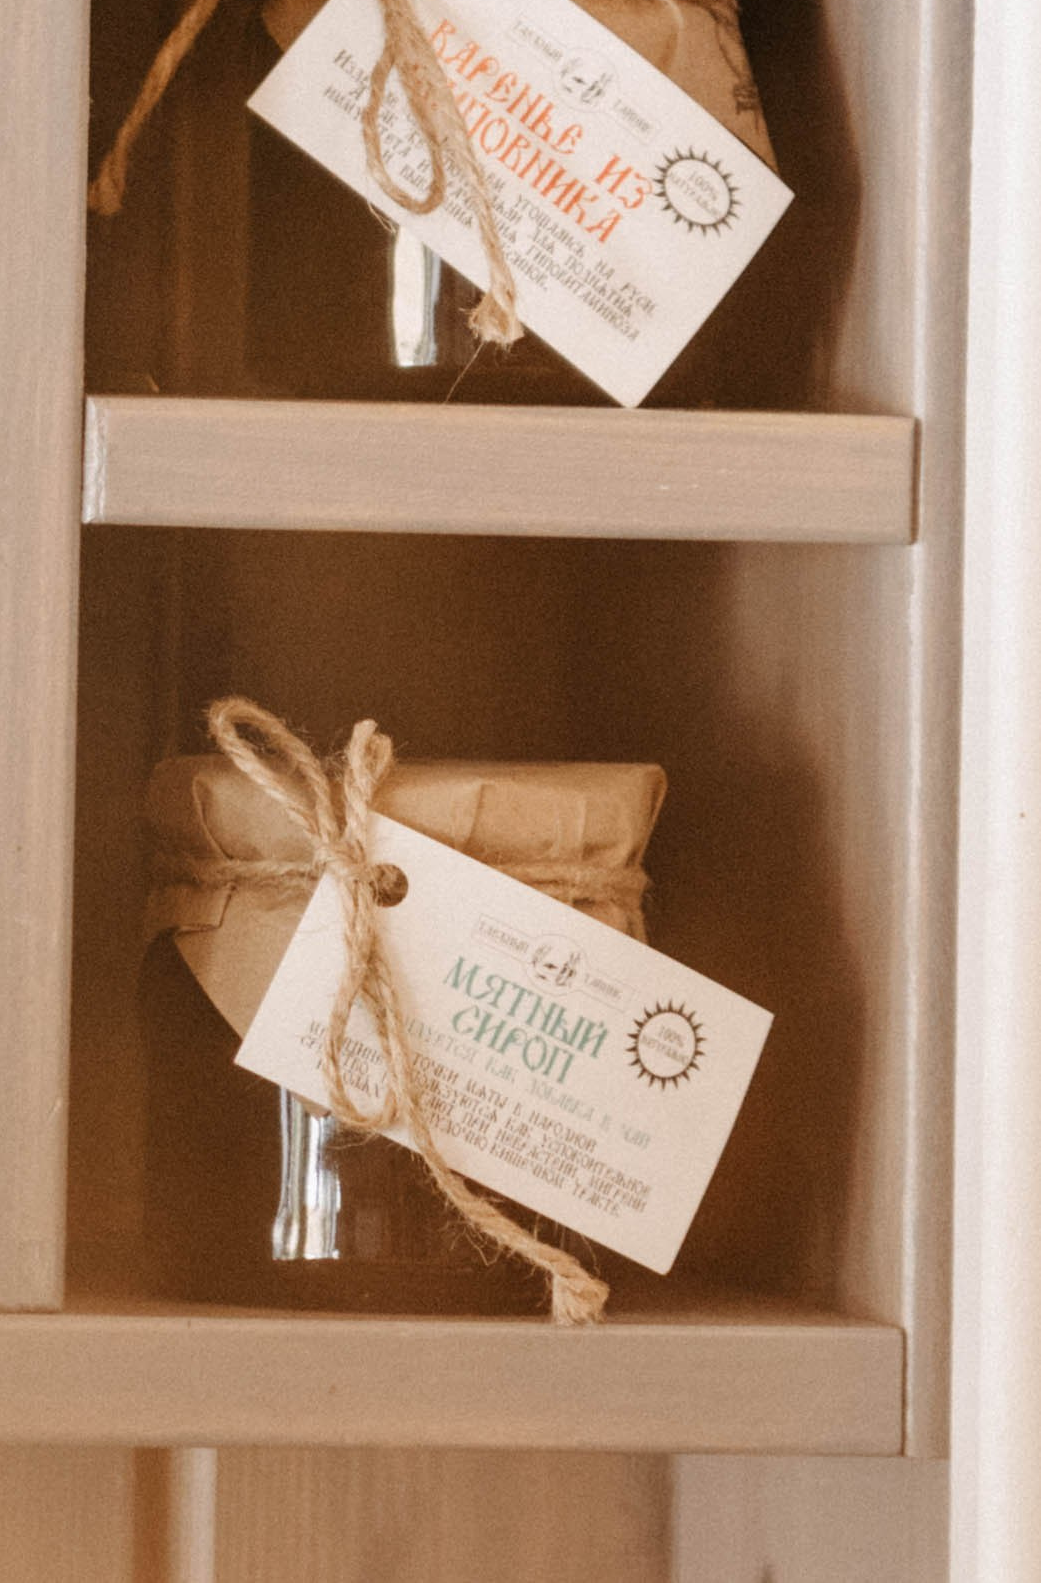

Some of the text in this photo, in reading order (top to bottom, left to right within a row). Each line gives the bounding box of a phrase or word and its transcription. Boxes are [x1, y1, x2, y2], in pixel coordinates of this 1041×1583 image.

[422, 17, 657, 214] ВАРЕНЬЕ ИЗ
[442, 954, 610, 1058] МЯТНЫЙ
[448, 999, 577, 1085] СИРОП
